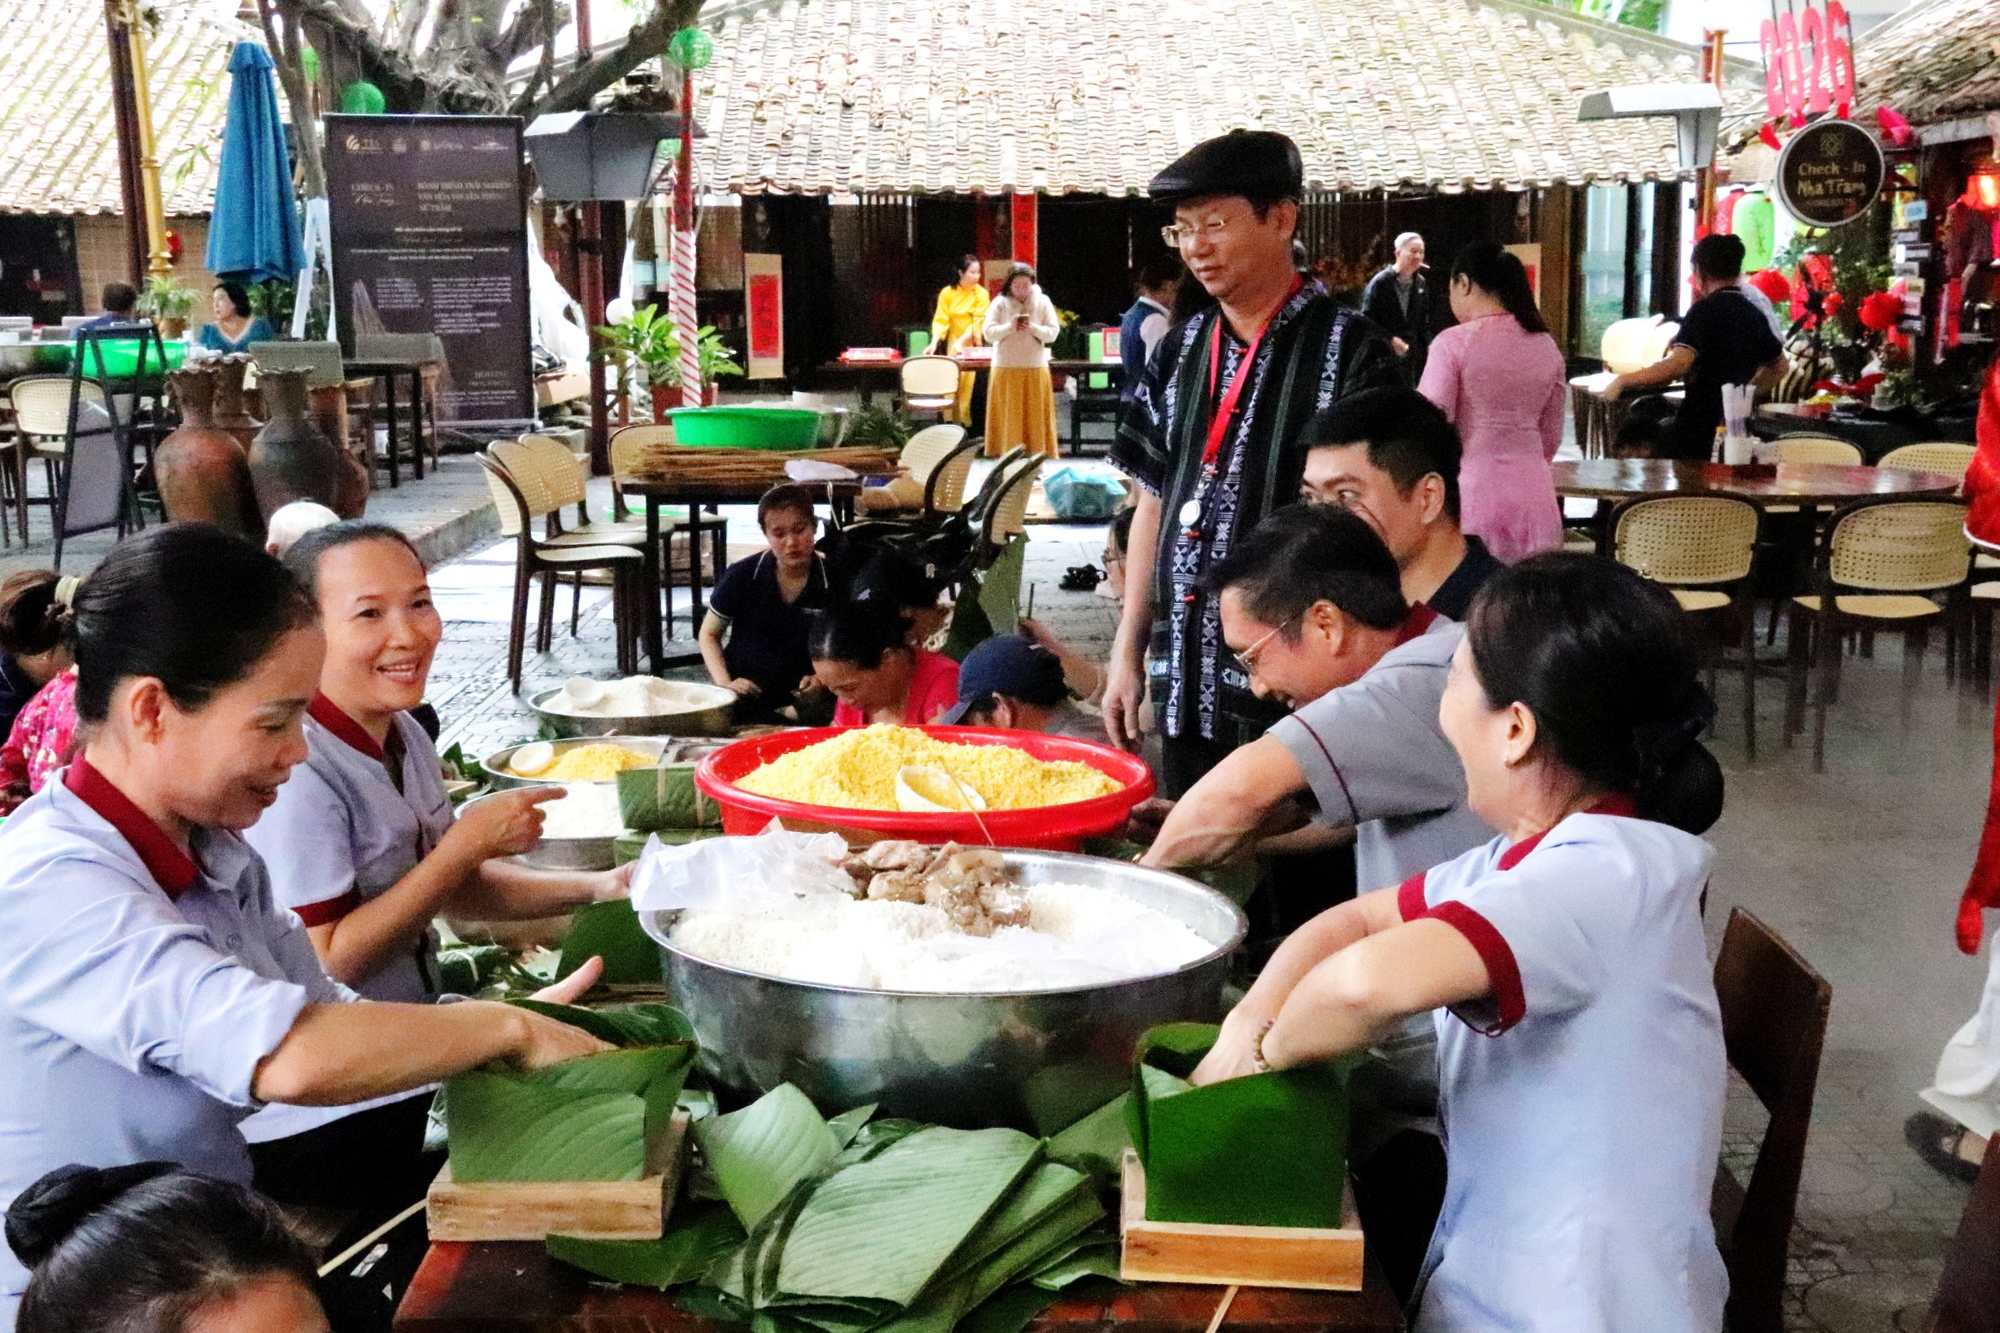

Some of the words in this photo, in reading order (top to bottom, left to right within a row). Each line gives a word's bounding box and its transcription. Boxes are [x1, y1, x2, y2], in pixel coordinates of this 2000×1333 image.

[1760, 1, 1853, 117] 2026
[1798, 162, 1840, 176] Check
[1797, 180, 1824, 197] Nha
